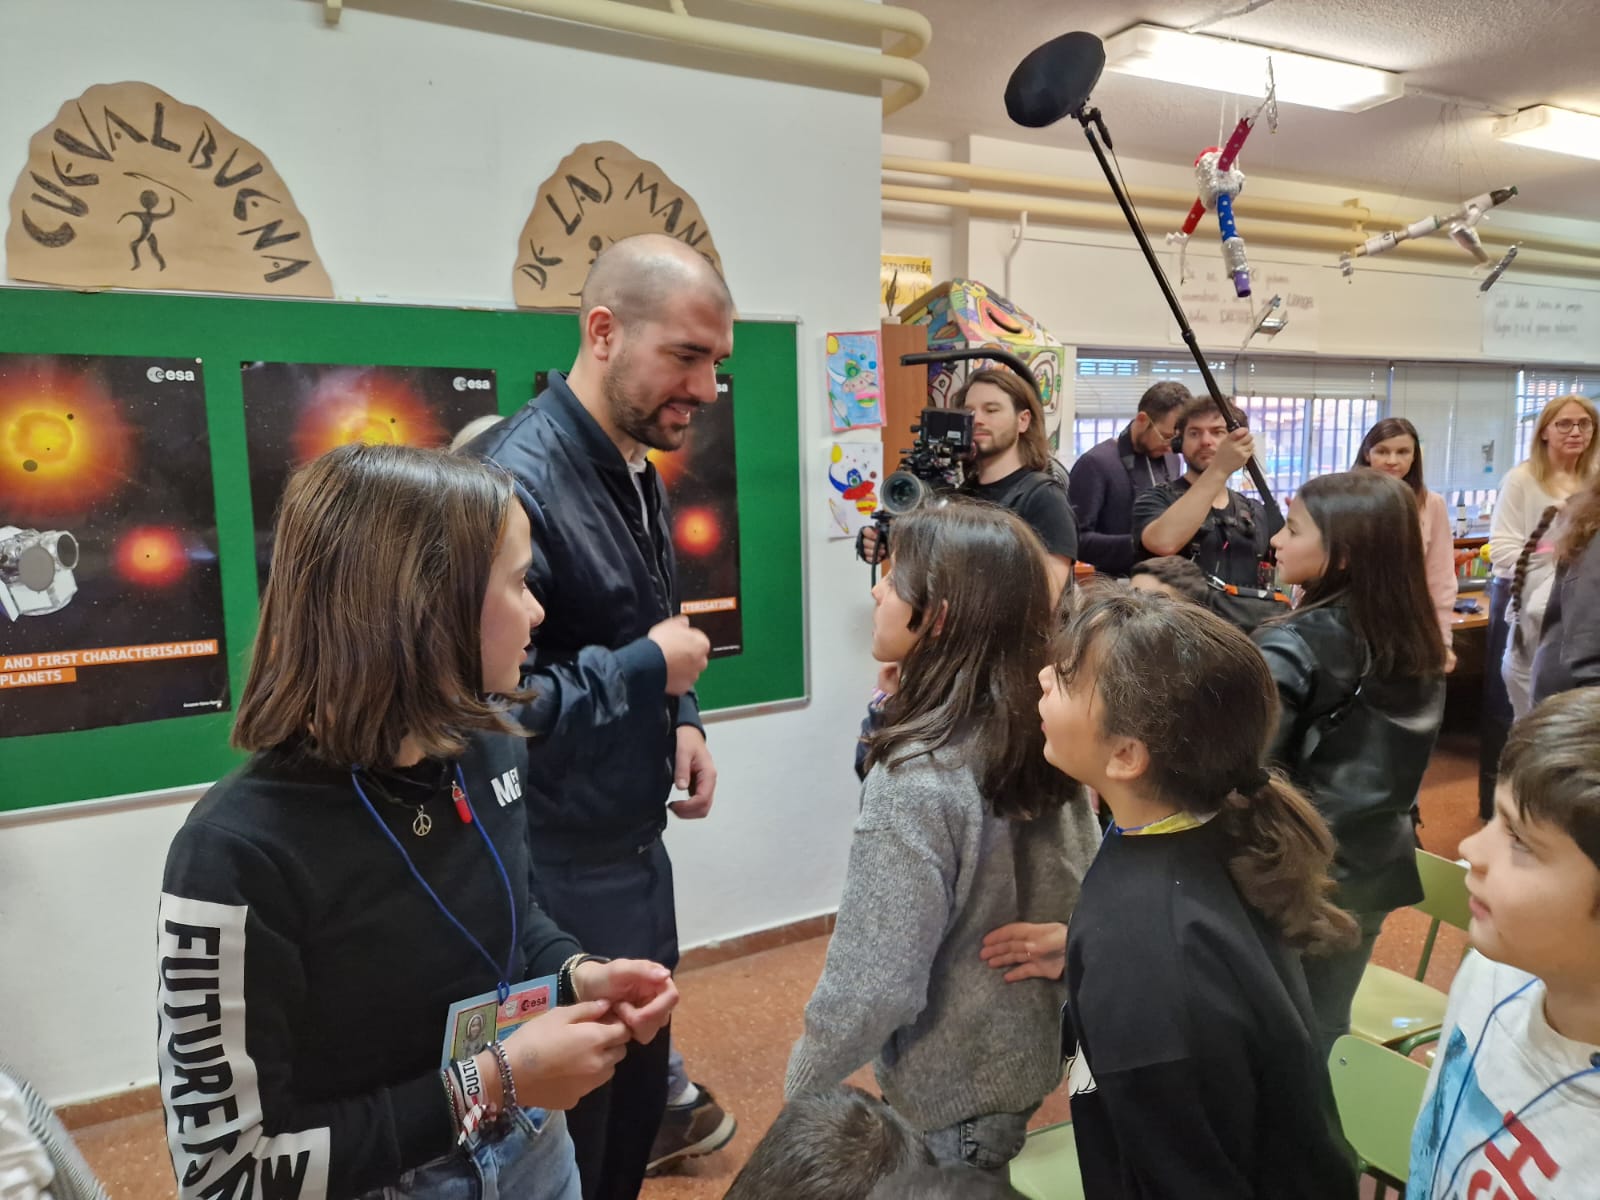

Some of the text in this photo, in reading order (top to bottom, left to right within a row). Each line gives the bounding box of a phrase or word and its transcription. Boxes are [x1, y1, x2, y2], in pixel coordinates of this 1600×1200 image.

[516, 238, 563, 291] DE
[545, 155, 613, 236] LAS
[0, 669, 62, 687] PLANETS
[4, 642, 214, 670] AND FIRST CHARACTERISATION
[160, 918, 241, 1134] FUTURE
